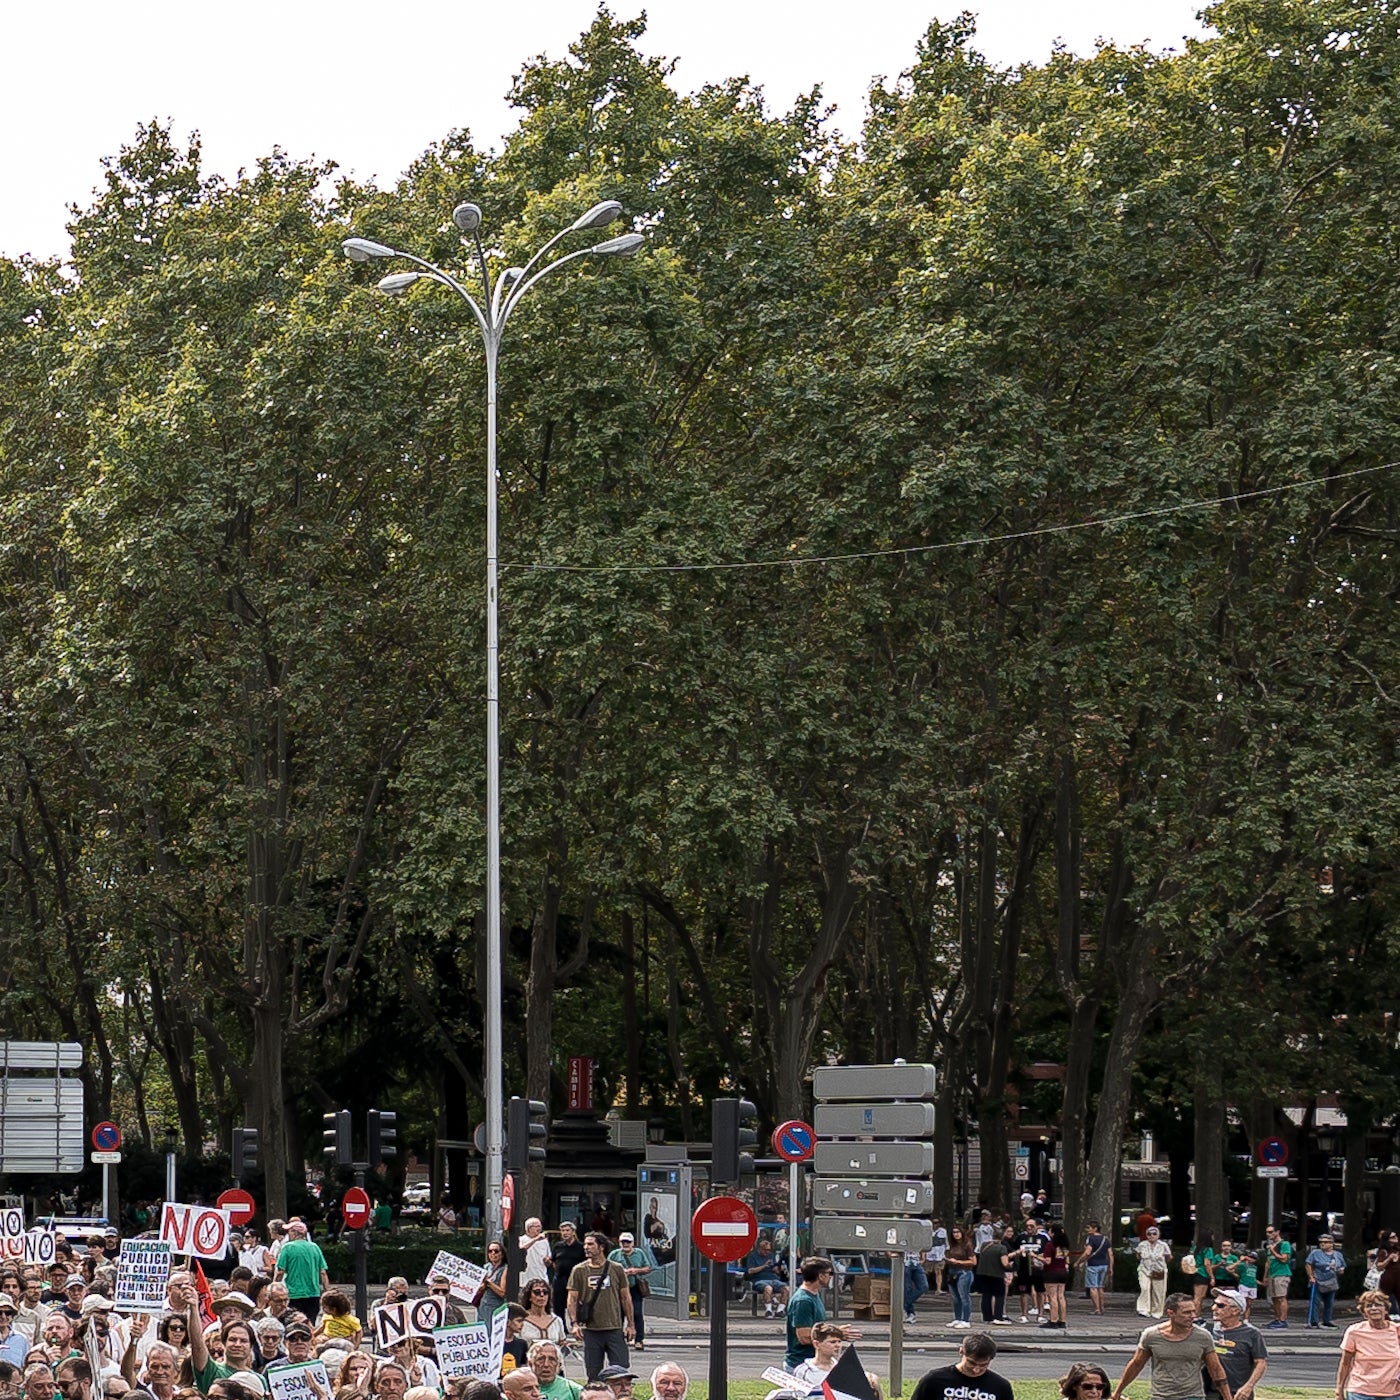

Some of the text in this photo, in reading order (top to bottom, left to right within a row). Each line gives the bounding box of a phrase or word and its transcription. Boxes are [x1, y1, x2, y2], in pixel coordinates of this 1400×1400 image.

[163, 1206, 225, 1255] NO
[25, 1233, 54, 1262] NO
[119, 1264, 167, 1274] DE CALIDAD
[117, 1282, 164, 1292] FEMINISTA
[117, 1291, 135, 1301] PARA
[380, 1299, 443, 1345] NO
[446, 1332, 487, 1348] ESCUELAS
[442, 1347, 490, 1363] PÚBLICAS
